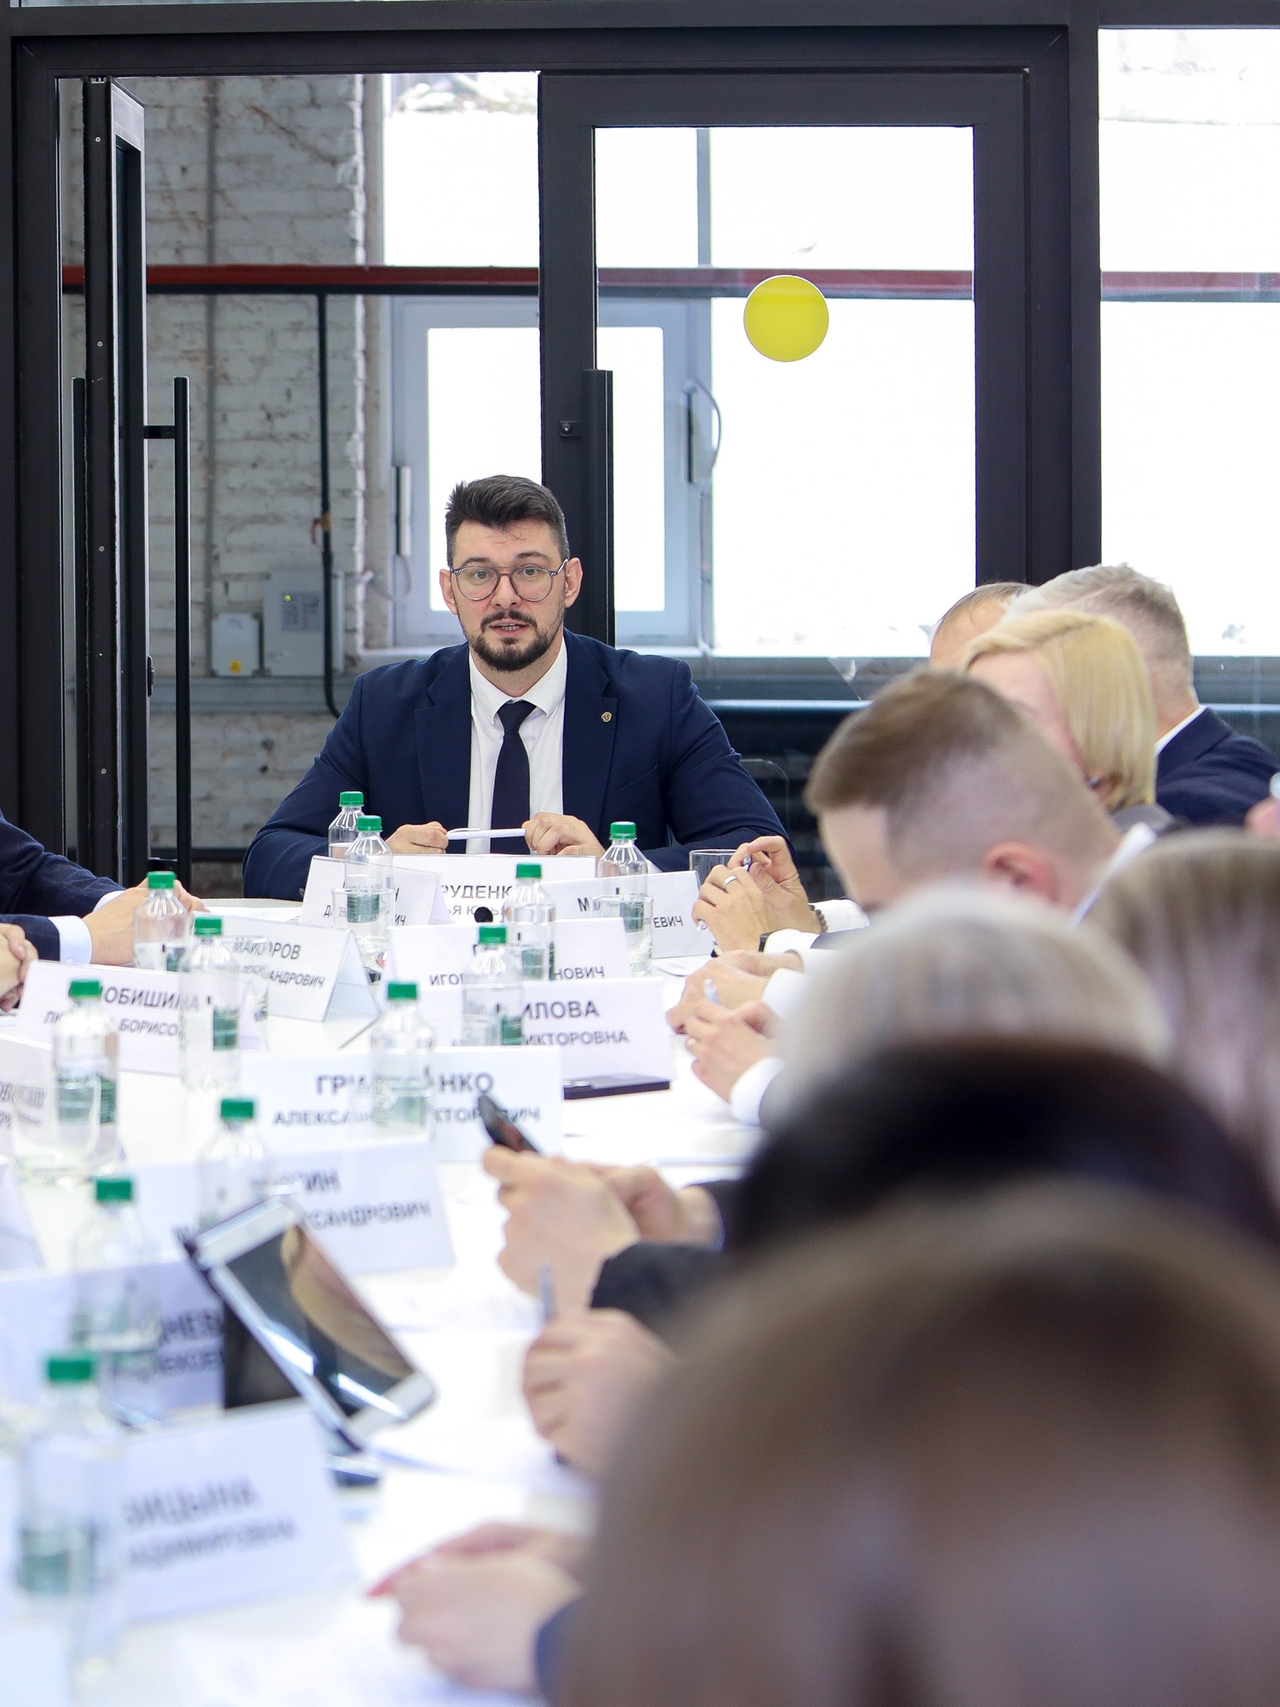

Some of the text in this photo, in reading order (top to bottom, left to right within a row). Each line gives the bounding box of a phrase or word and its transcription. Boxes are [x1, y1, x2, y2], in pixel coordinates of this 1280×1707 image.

[441, 884, 513, 900] РУДЕНК
[653, 916, 684, 929] ЕВИЧ
[553, 966, 605, 982] НОВИЧ
[523, 1000, 600, 1020] ИЛОВА
[523, 1028, 630, 1046] ИКТОРОВНА
